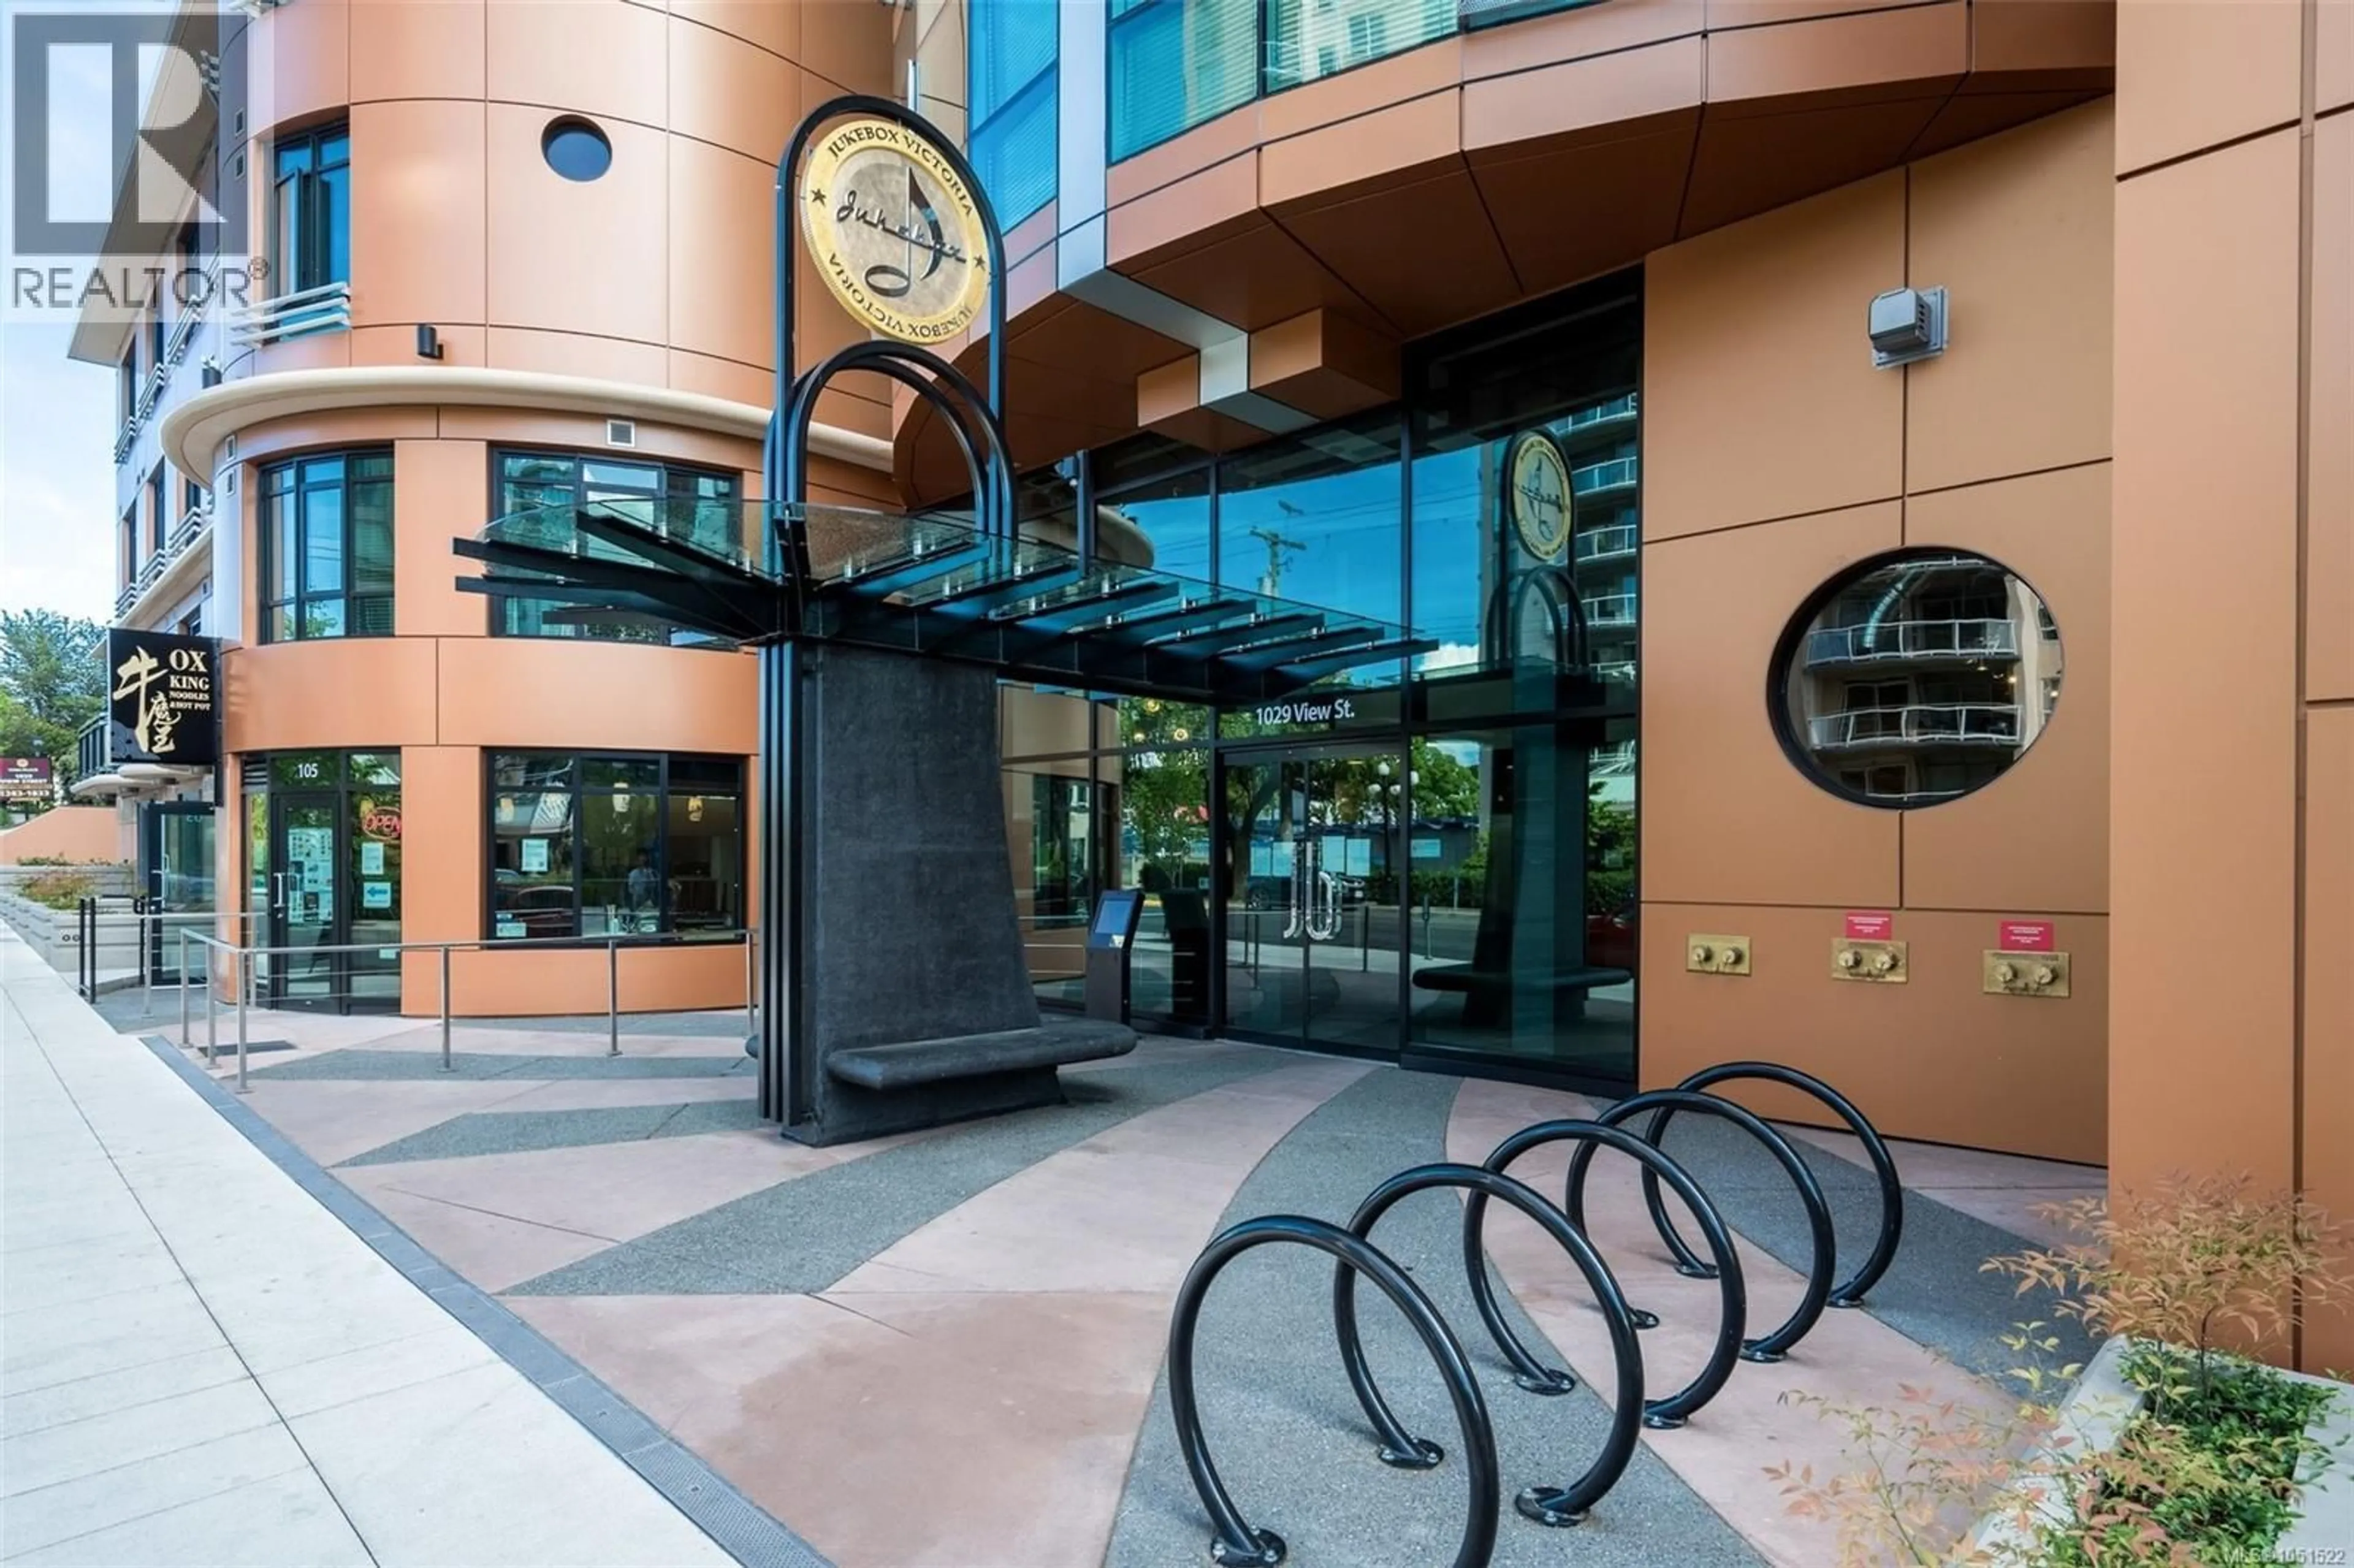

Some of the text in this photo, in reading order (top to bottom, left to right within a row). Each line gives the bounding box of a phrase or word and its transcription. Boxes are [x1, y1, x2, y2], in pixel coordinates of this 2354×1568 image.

[828, 126, 973, 218] JUKEBOX VICTORIA
[828, 252, 905, 333] VICTORIA
[169, 649, 208, 672] OX
[170, 675, 210, 691] KING
[169, 691, 210, 701] NOODLES
[1256, 698, 1355, 725] 1029 View St.
[297, 763, 319, 778] 105
